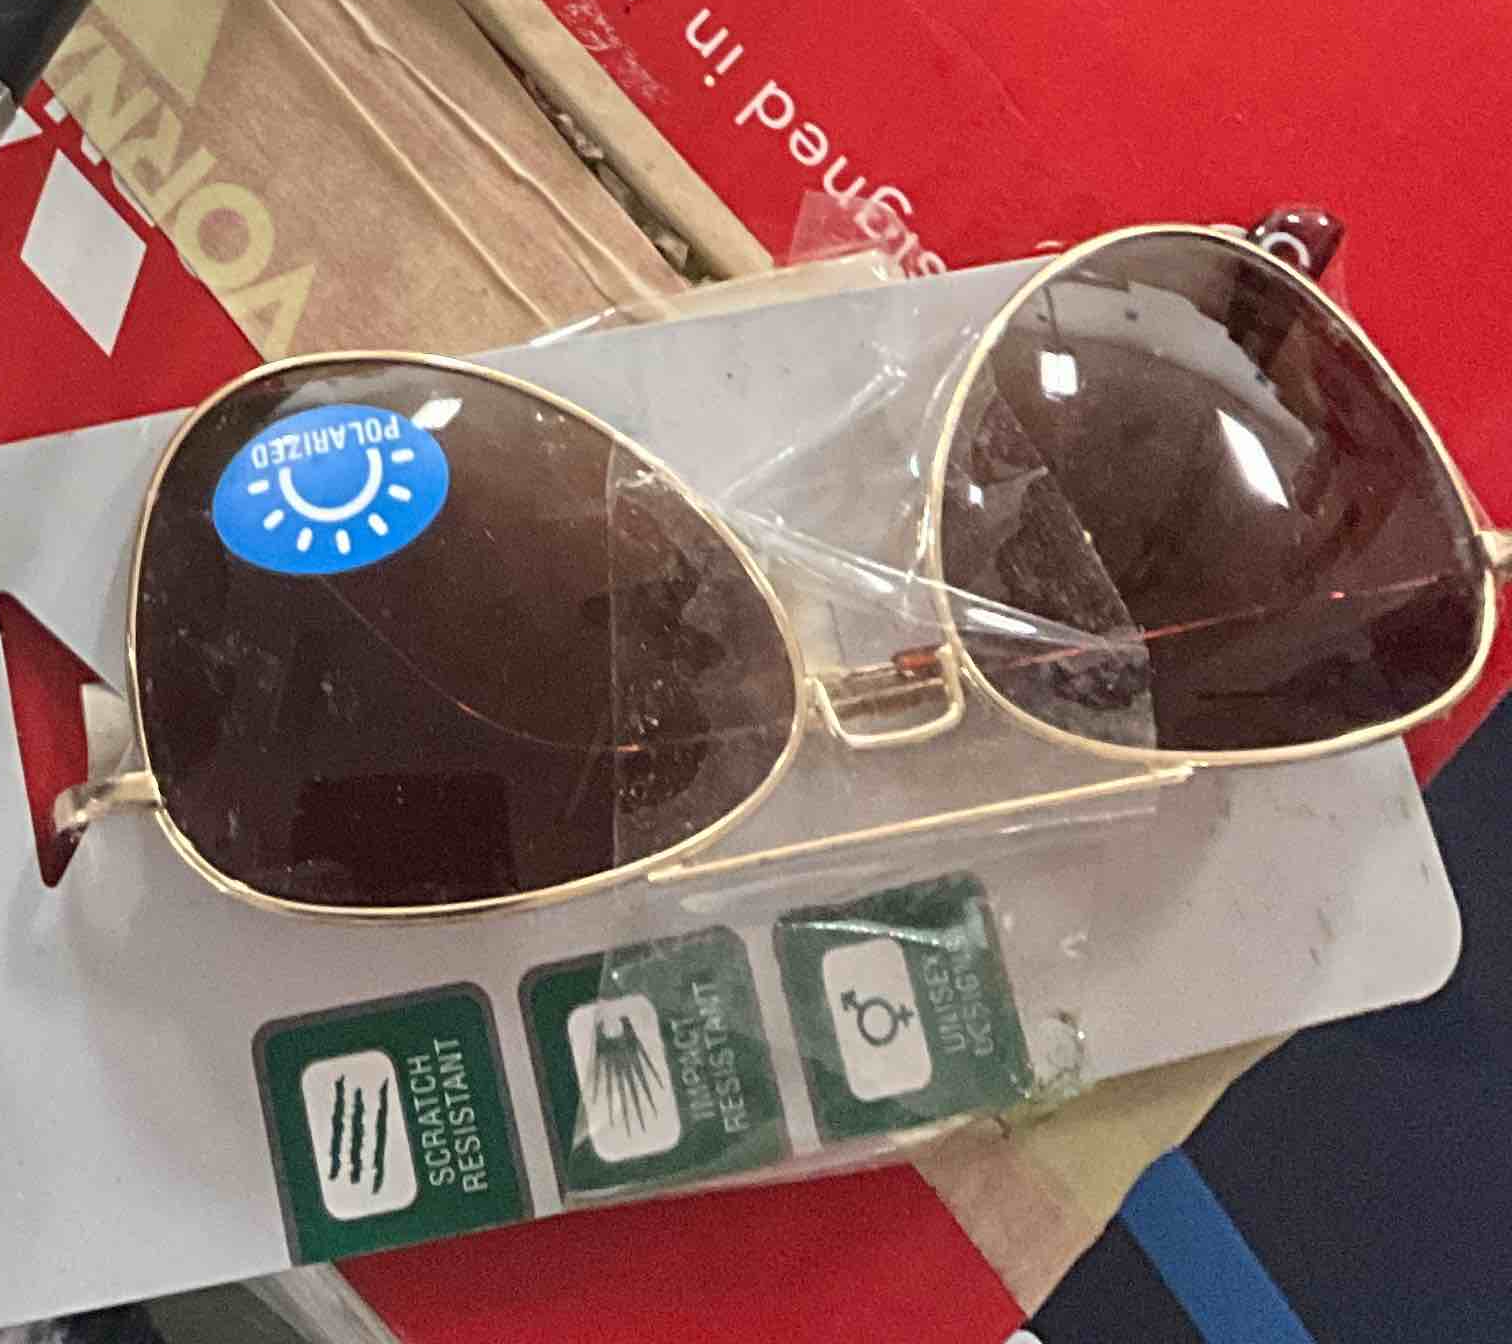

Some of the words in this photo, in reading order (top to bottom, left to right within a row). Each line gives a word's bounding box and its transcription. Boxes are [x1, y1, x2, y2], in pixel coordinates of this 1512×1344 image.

[674, 4, 748, 82] in
[249, 414, 402, 469] POLARIZED
[671, 1018, 715, 1120] IMPACT
[691, 981, 749, 1133] RESISTANT
[405, 1054, 456, 1187] SCRATCH
[433, 1039, 487, 1194] RESISTANT
